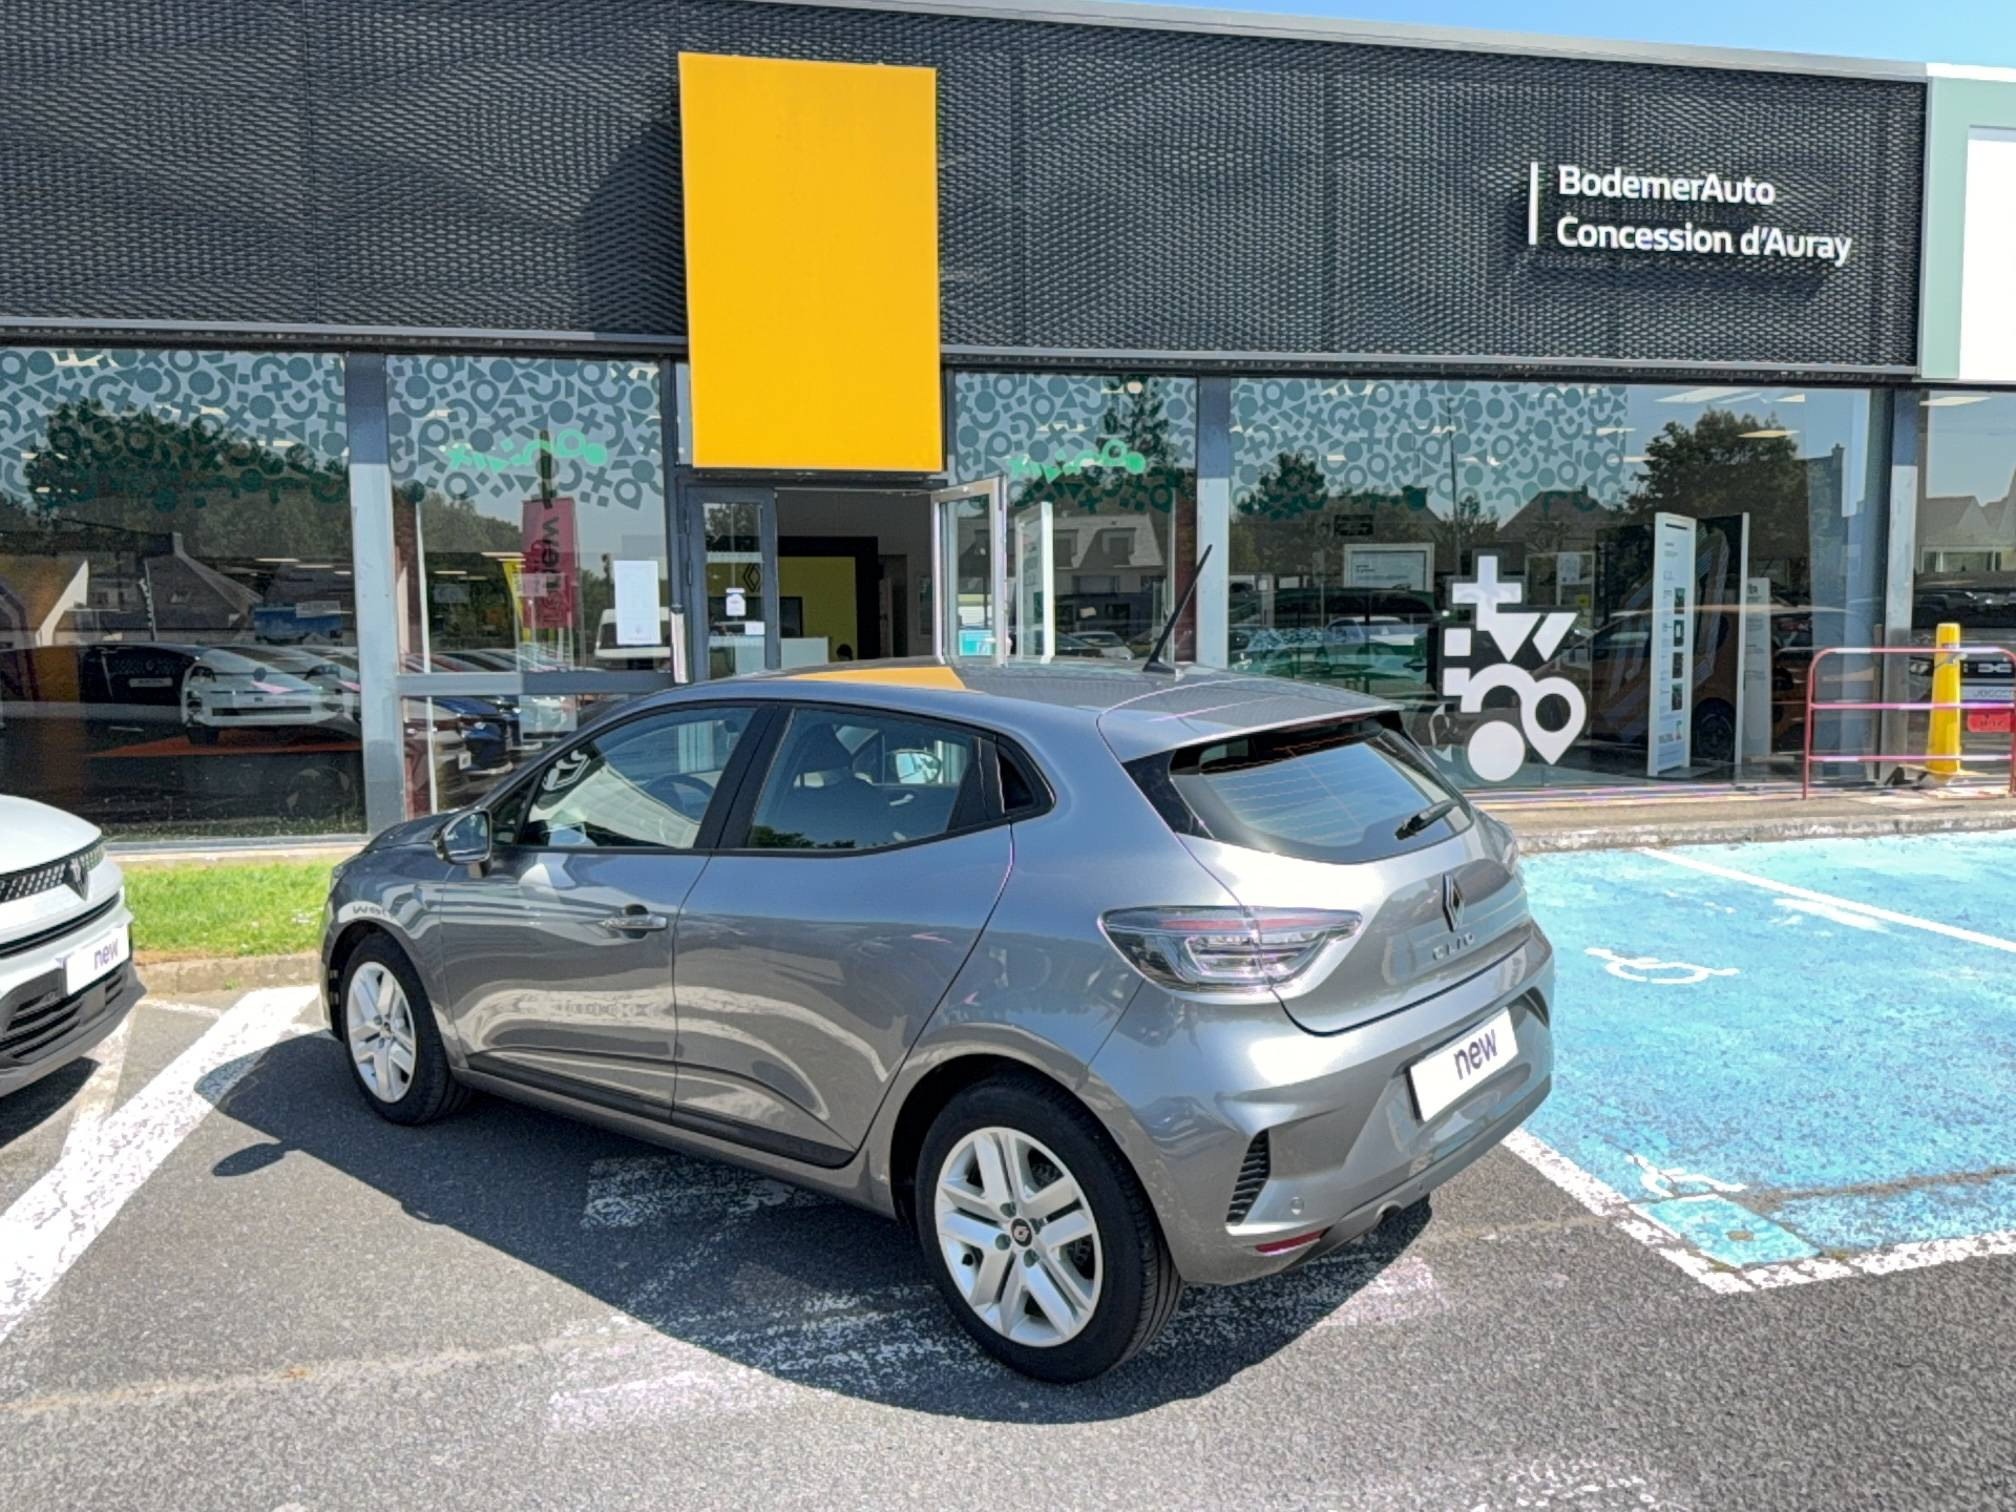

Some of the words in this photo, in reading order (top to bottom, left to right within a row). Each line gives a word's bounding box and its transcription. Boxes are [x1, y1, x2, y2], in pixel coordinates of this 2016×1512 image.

[1558, 164, 1776, 206] BodemerAuto
[1556, 216, 1734, 254] Concession
[1740, 225, 1853, 268] d'Auray
[94, 938, 119, 970] new
[1432, 932, 1475, 960] CLIO
[1453, 1029, 1498, 1081] new
